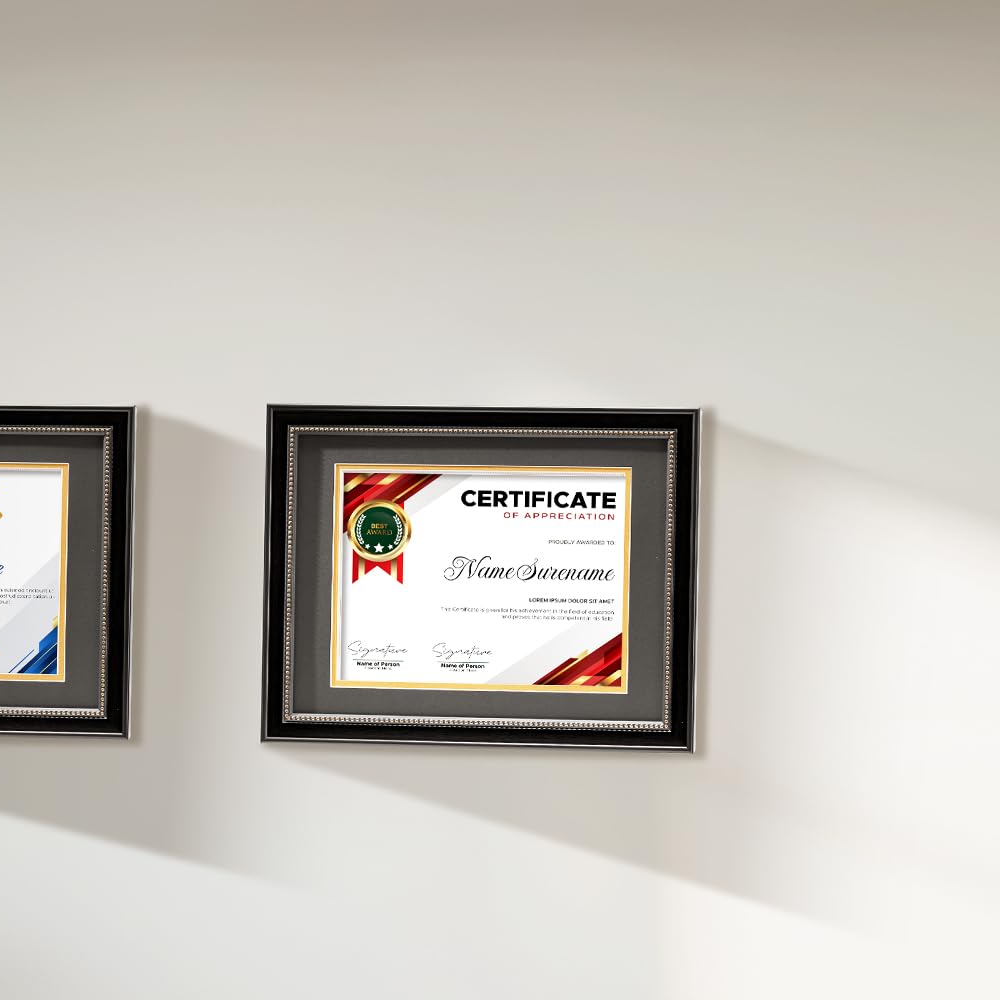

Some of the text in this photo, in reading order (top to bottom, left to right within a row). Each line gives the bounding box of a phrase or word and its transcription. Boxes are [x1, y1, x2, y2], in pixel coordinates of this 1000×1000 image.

[460, 489, 617, 509] CERTIFICATE
[503, 511, 615, 521] OF APPRECIATION
